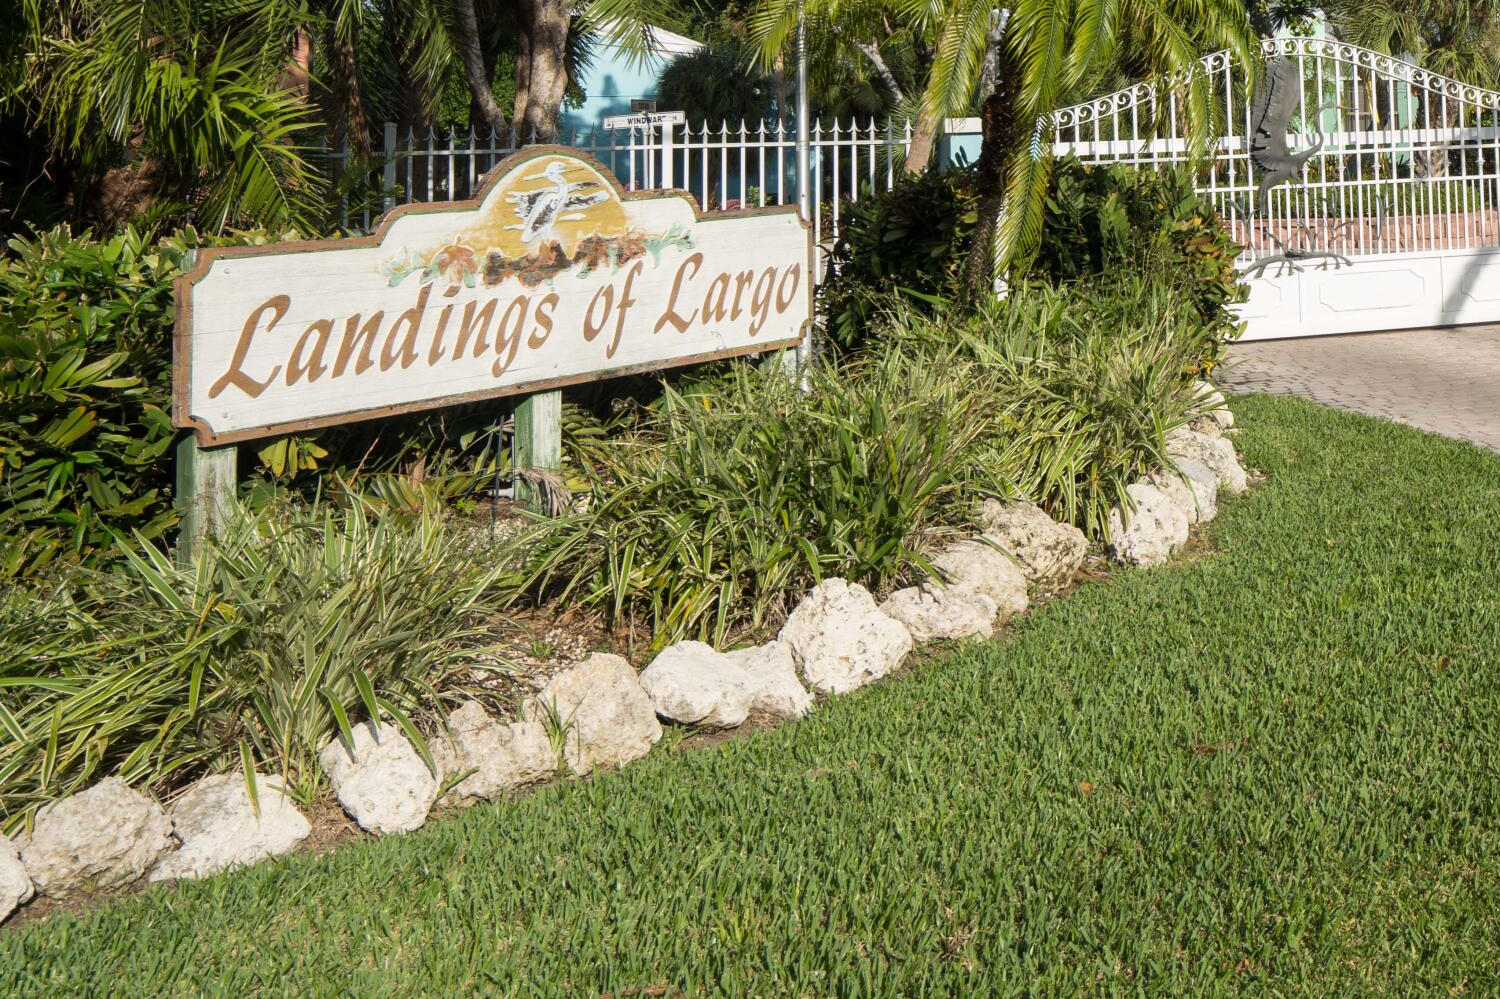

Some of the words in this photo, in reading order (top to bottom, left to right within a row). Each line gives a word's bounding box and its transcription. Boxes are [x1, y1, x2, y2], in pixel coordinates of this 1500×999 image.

[627, 115, 667, 125] WINDWAR
[208, 281, 560, 399] Landings
[583, 260, 642, 360] of
[653, 252, 800, 338] Largo
